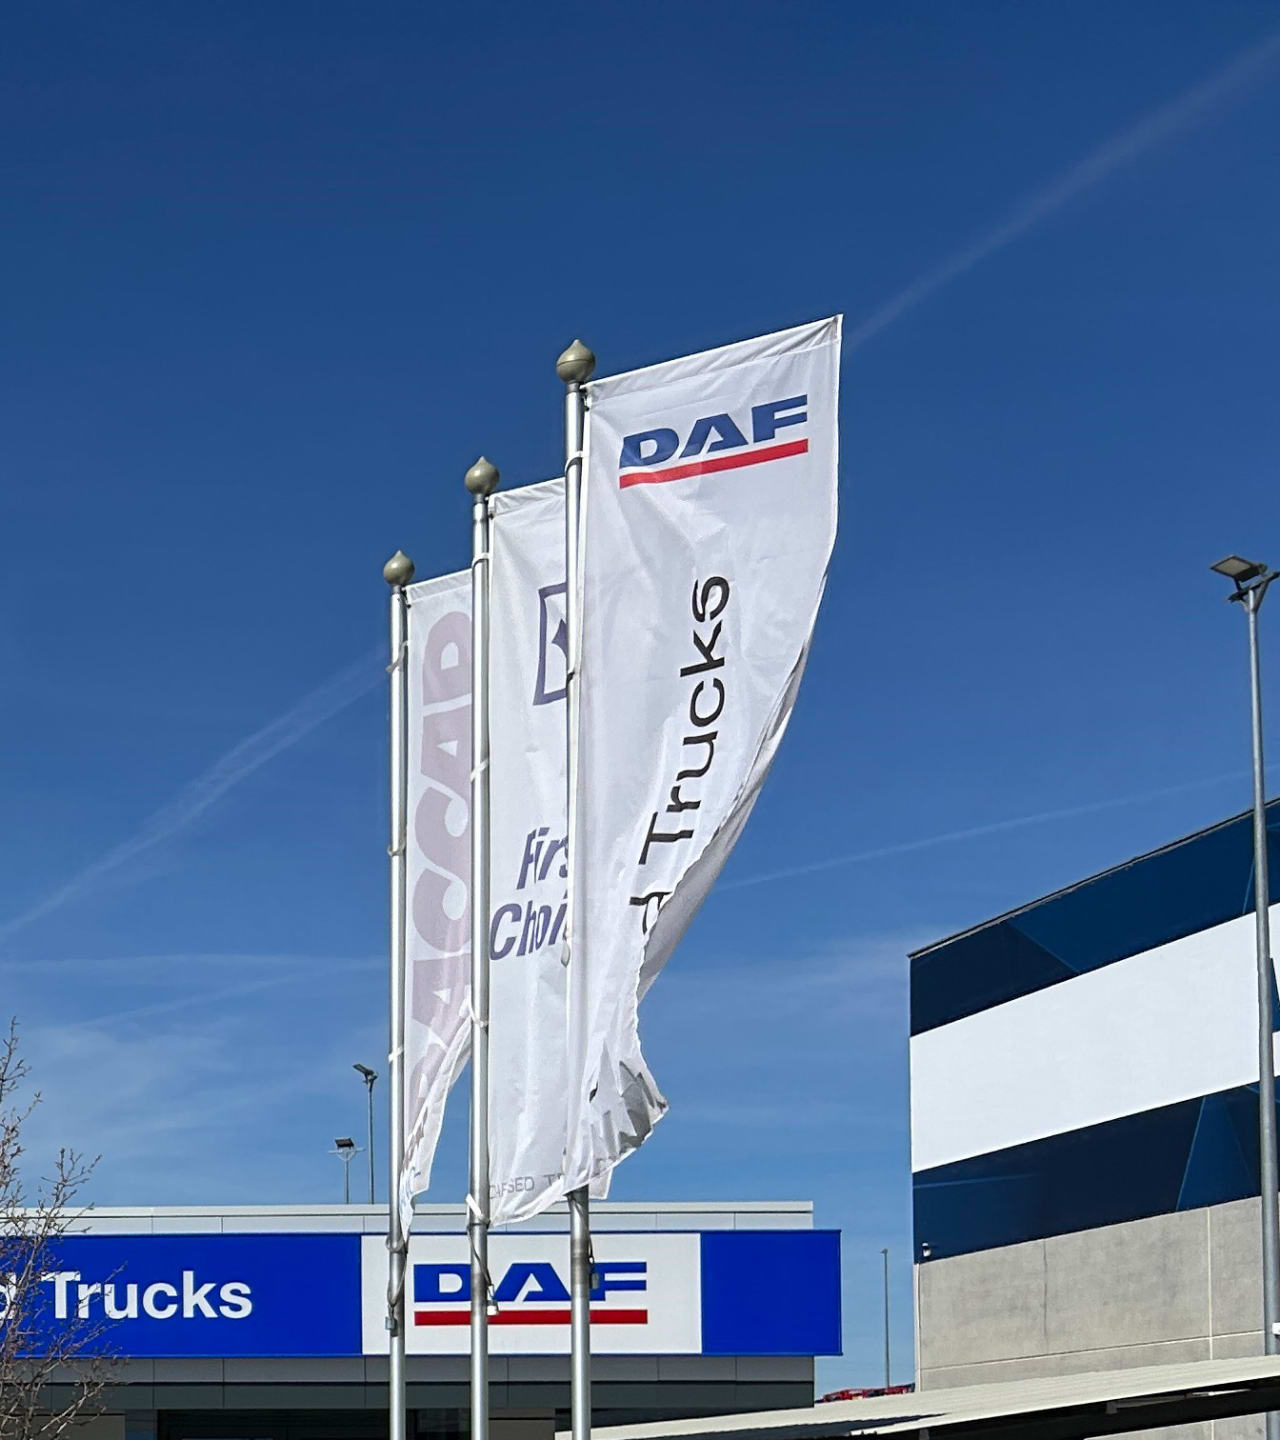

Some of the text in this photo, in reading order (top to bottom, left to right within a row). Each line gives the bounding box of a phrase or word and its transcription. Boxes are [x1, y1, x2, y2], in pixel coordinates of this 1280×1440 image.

[620, 394, 808, 469] DAF
[639, 575, 731, 865] Trucks
[41, 1270, 253, 1319] Trucks
[414, 1262, 648, 1302] DAF
